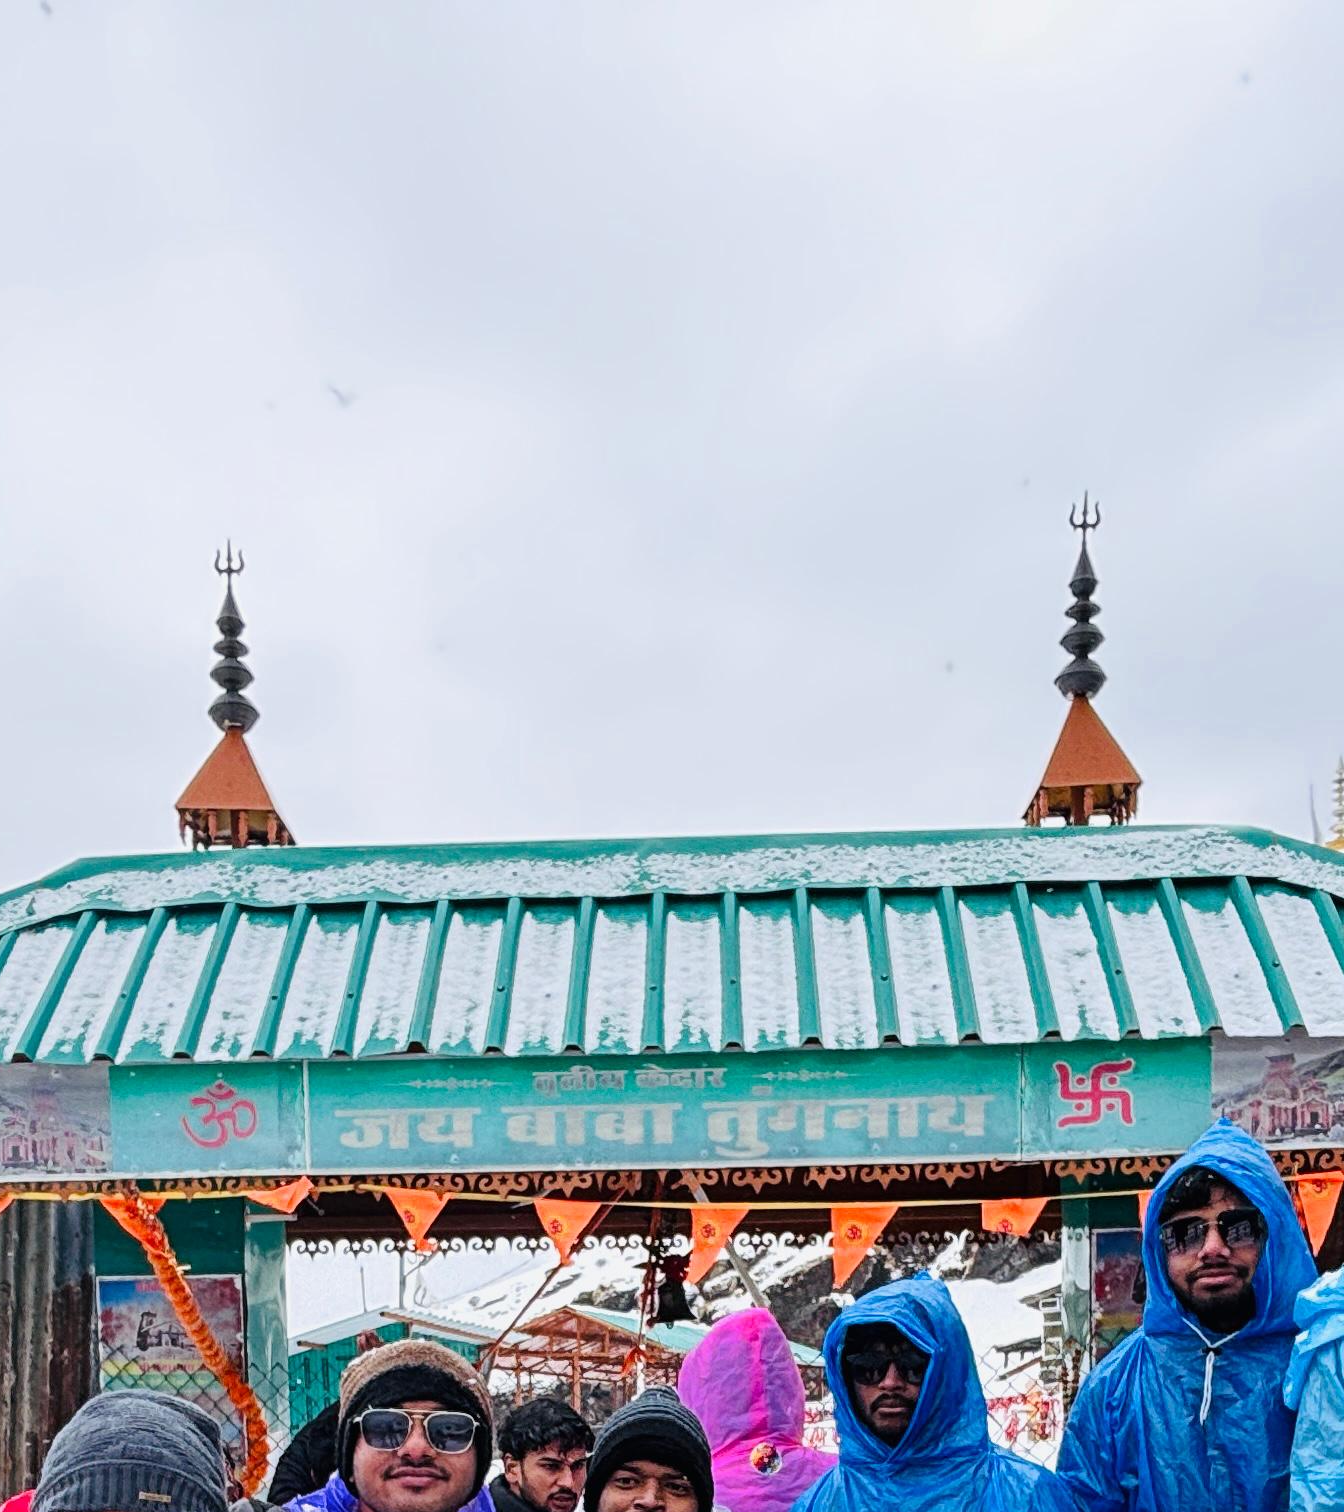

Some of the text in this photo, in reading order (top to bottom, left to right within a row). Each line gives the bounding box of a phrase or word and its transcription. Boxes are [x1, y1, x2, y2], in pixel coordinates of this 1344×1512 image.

[634, 1062, 728, 1089] केदार
[334, 1085, 995, 1158] जय बाबा तुंगनाथ
